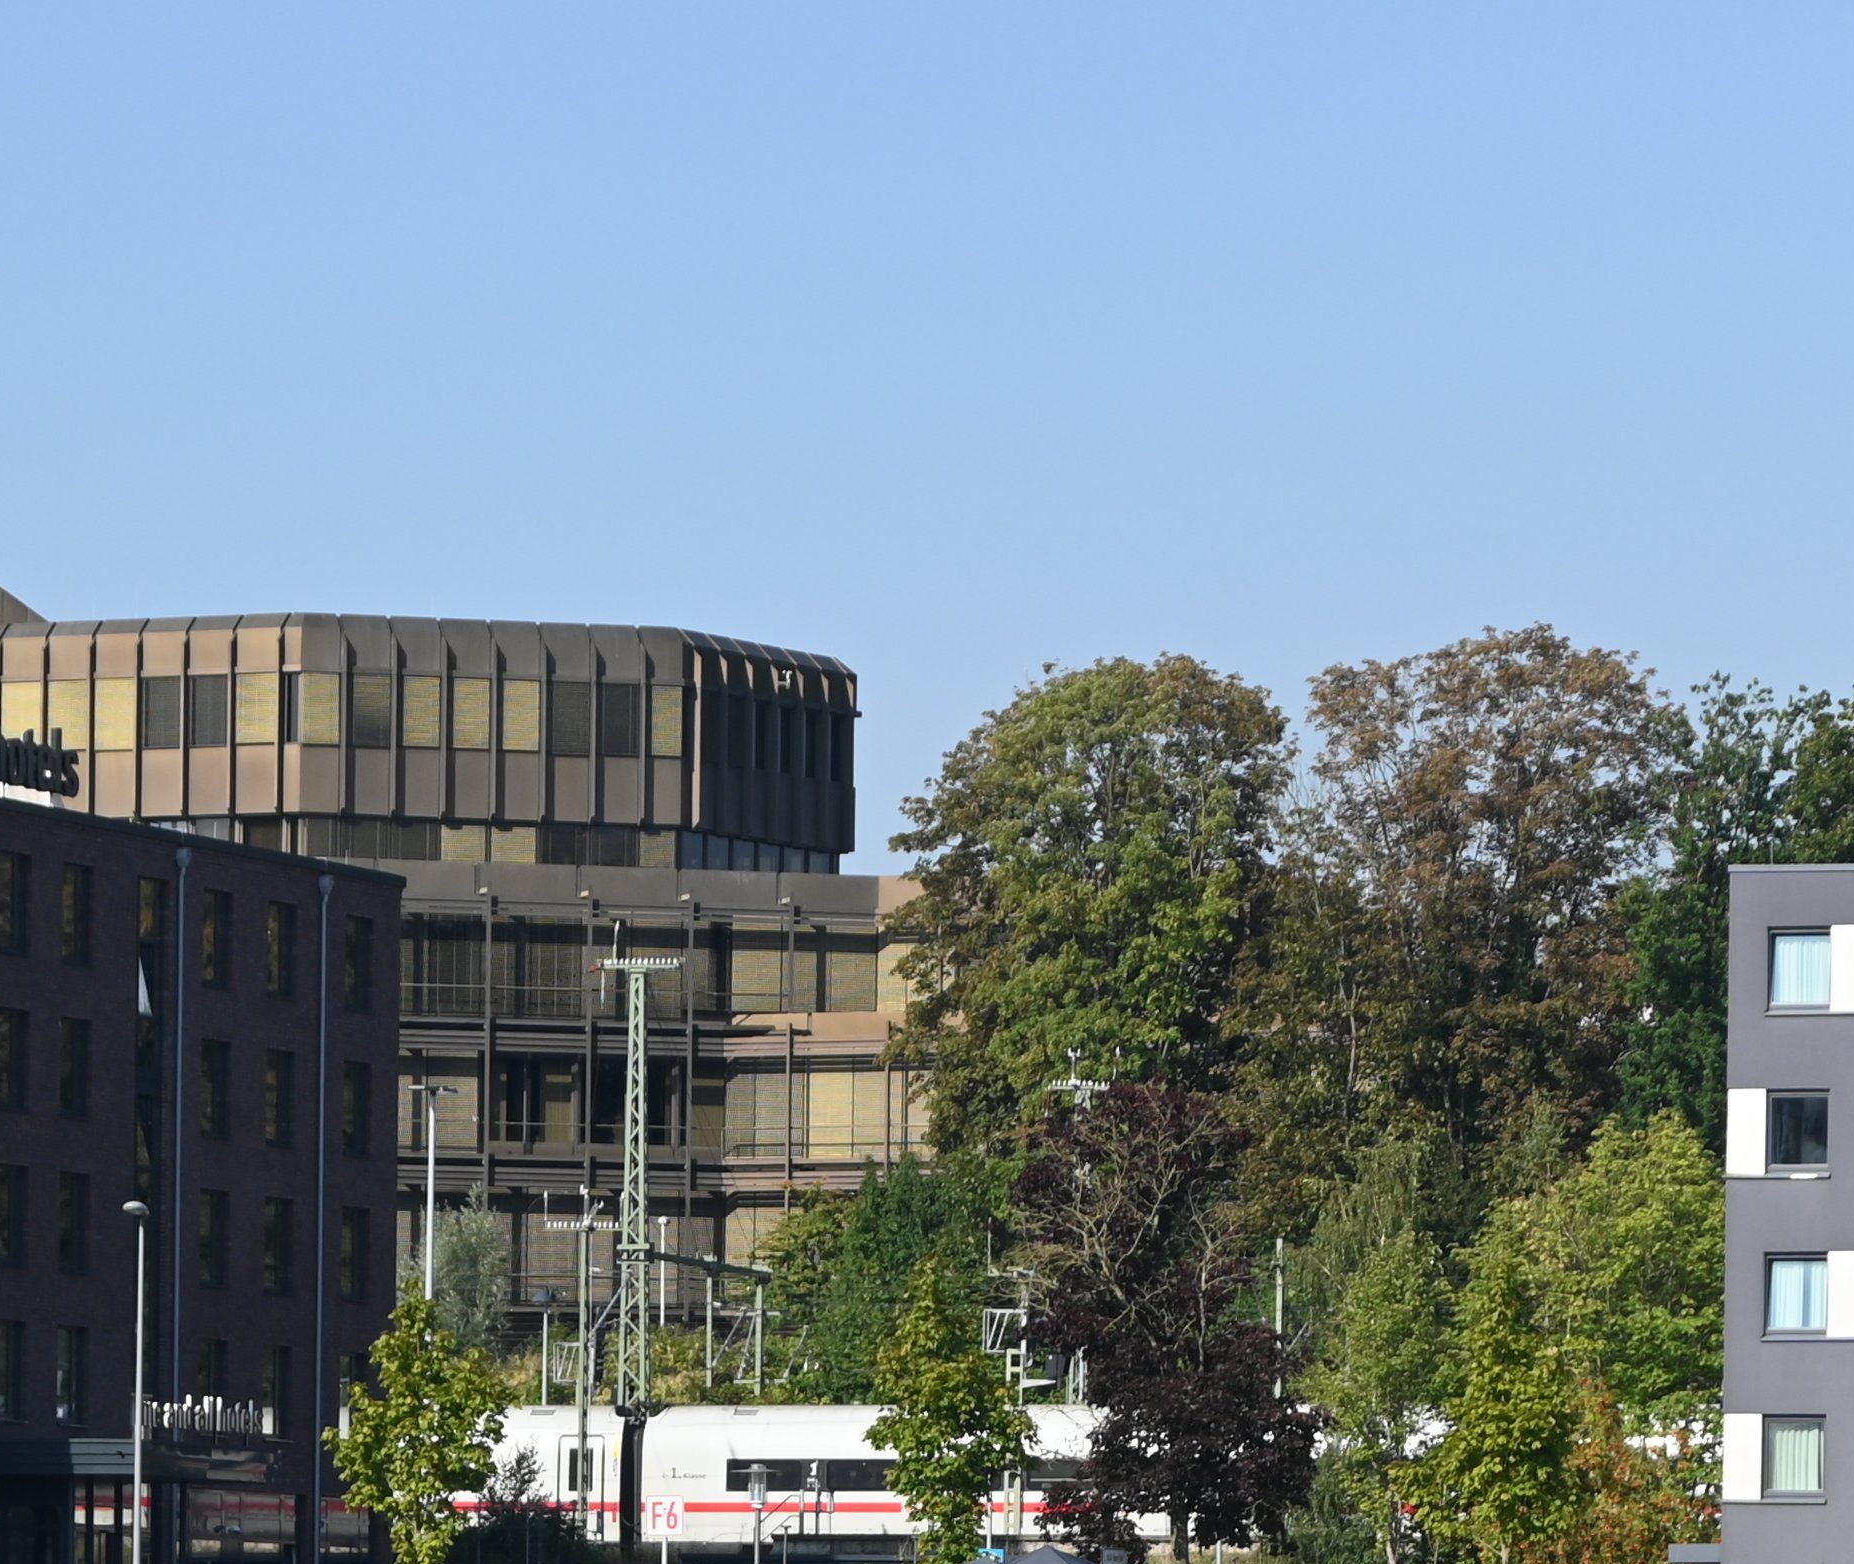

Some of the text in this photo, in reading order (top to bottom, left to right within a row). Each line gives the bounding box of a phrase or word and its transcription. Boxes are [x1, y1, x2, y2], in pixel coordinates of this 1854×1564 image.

[163, 1393, 193, 1430] and
[216, 1396, 263, 1434] hotels
[651, 1501, 678, 1530] F6
